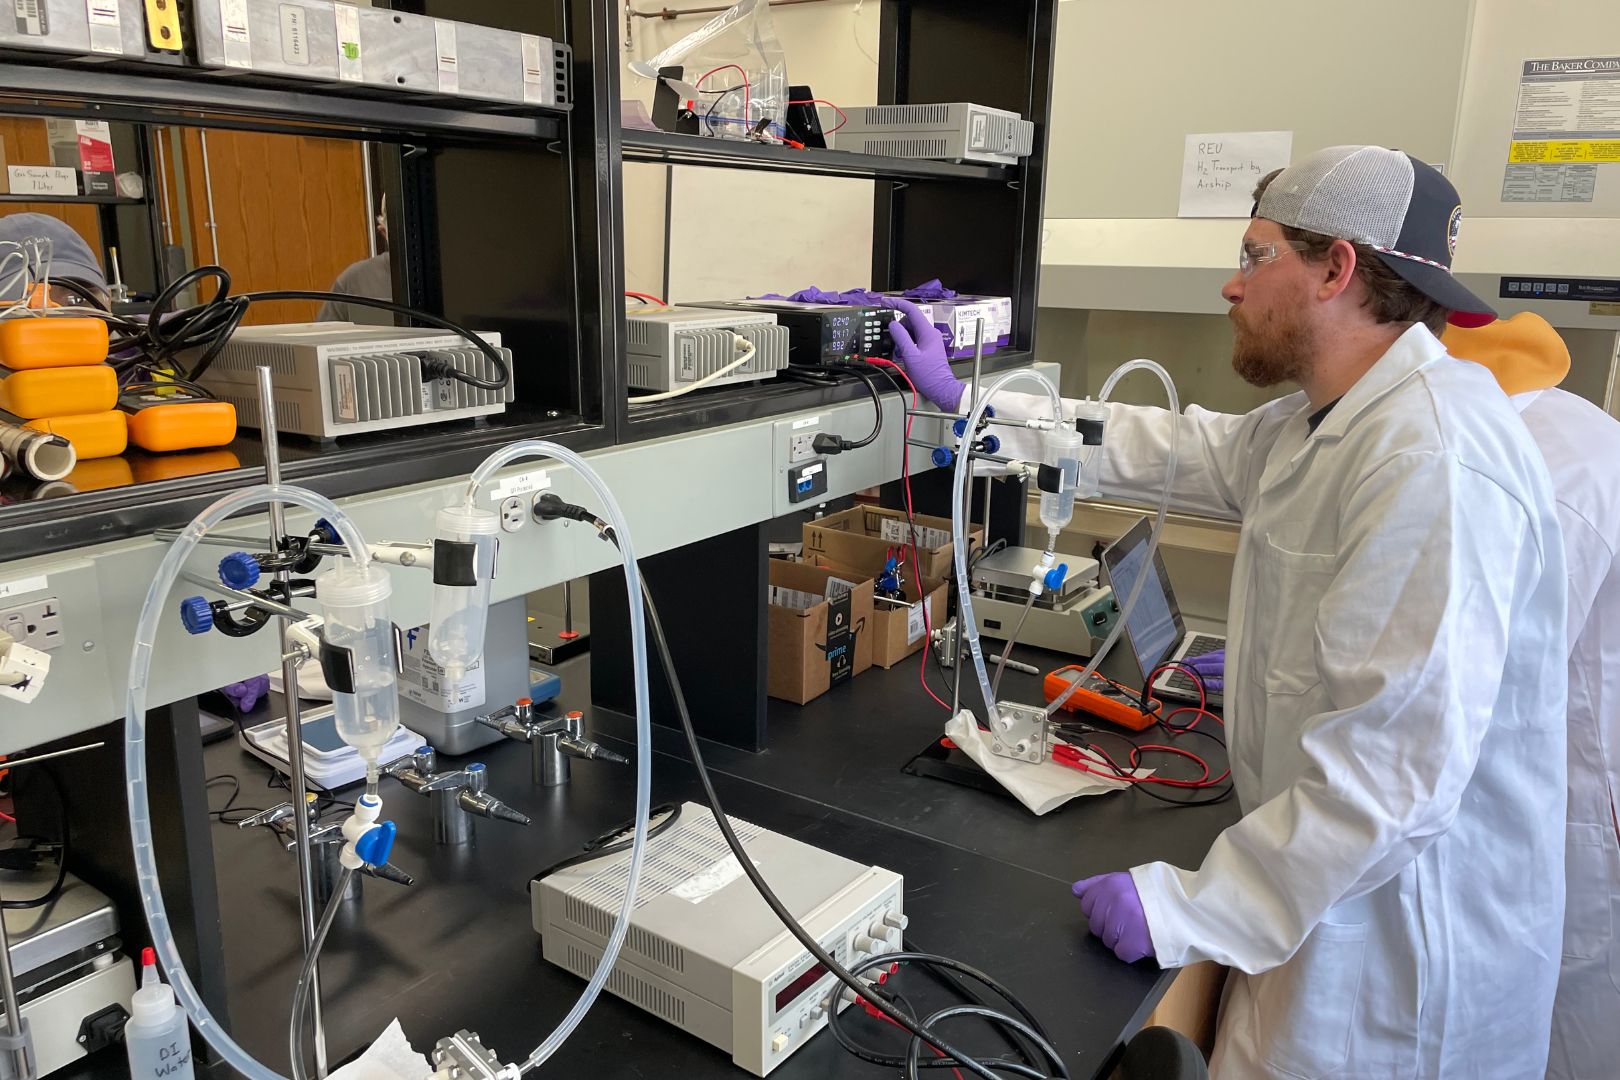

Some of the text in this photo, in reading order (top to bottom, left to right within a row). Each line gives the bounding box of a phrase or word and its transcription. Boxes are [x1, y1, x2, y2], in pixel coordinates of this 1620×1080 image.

[1530, 62, 1550, 72] THE
[1552, 61, 1583, 70] BAKER
[1250, 160, 1261, 174] by
[828, 645, 847, 660] prime
[160, 1041, 180, 1062] DI
